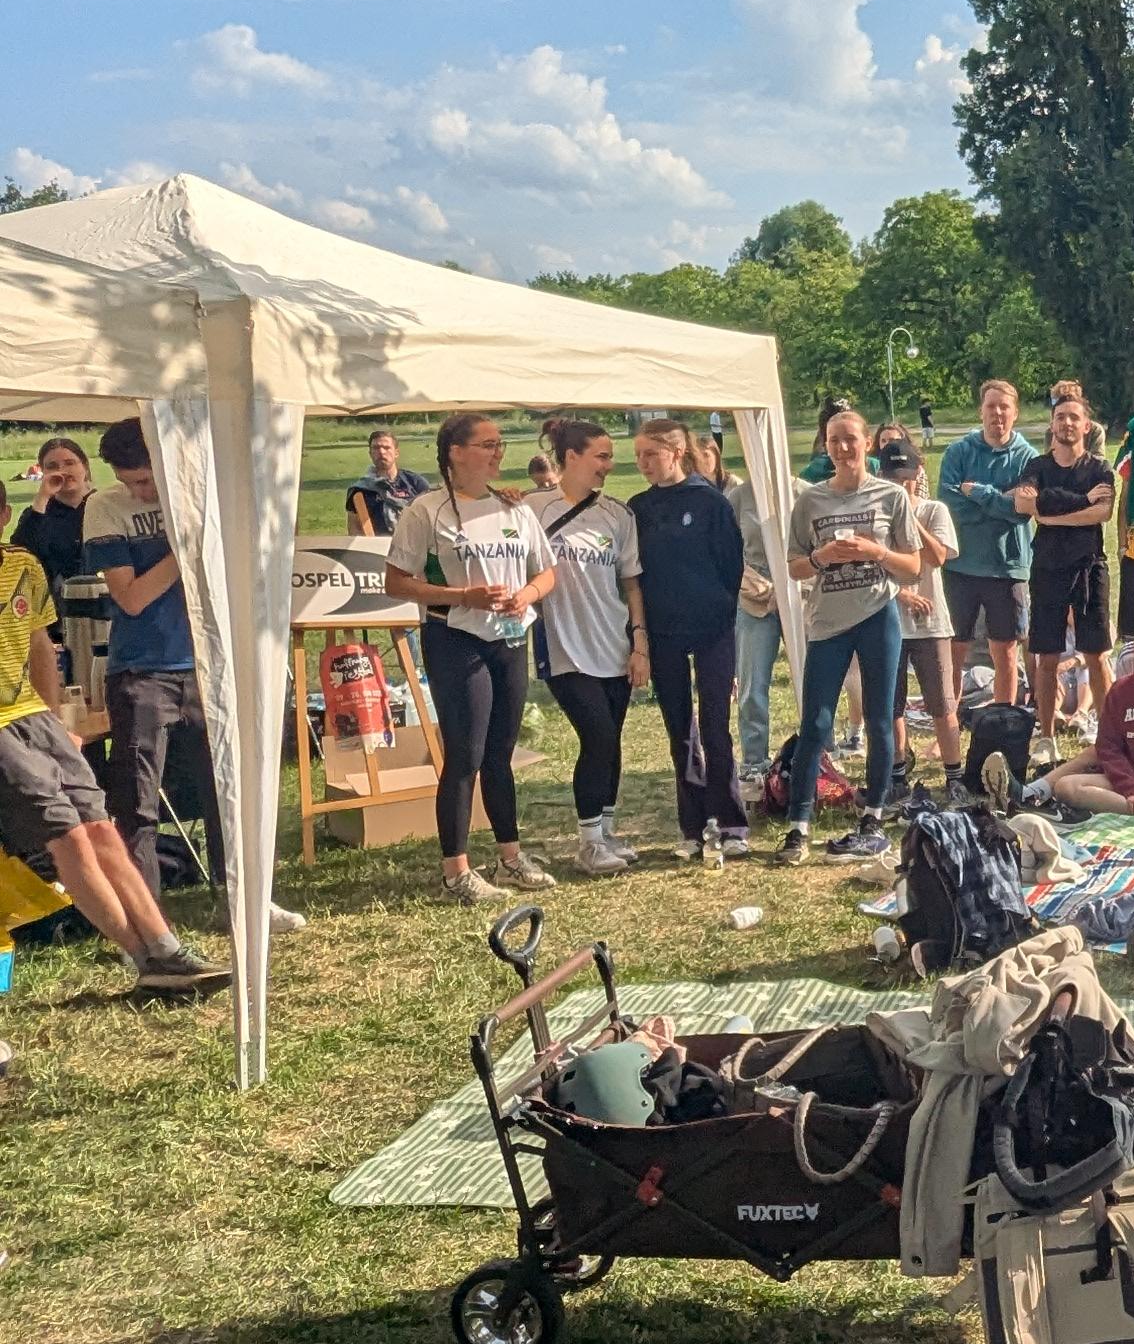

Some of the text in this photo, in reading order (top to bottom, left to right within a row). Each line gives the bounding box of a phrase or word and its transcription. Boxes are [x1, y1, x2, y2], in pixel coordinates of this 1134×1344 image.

[452, 542, 526, 563] TANZANIA
[551, 544, 617, 567] TANZANIA
[292, 572, 386, 588] OSPEL TRI
[737, 1204, 805, 1222] FUXTEC
